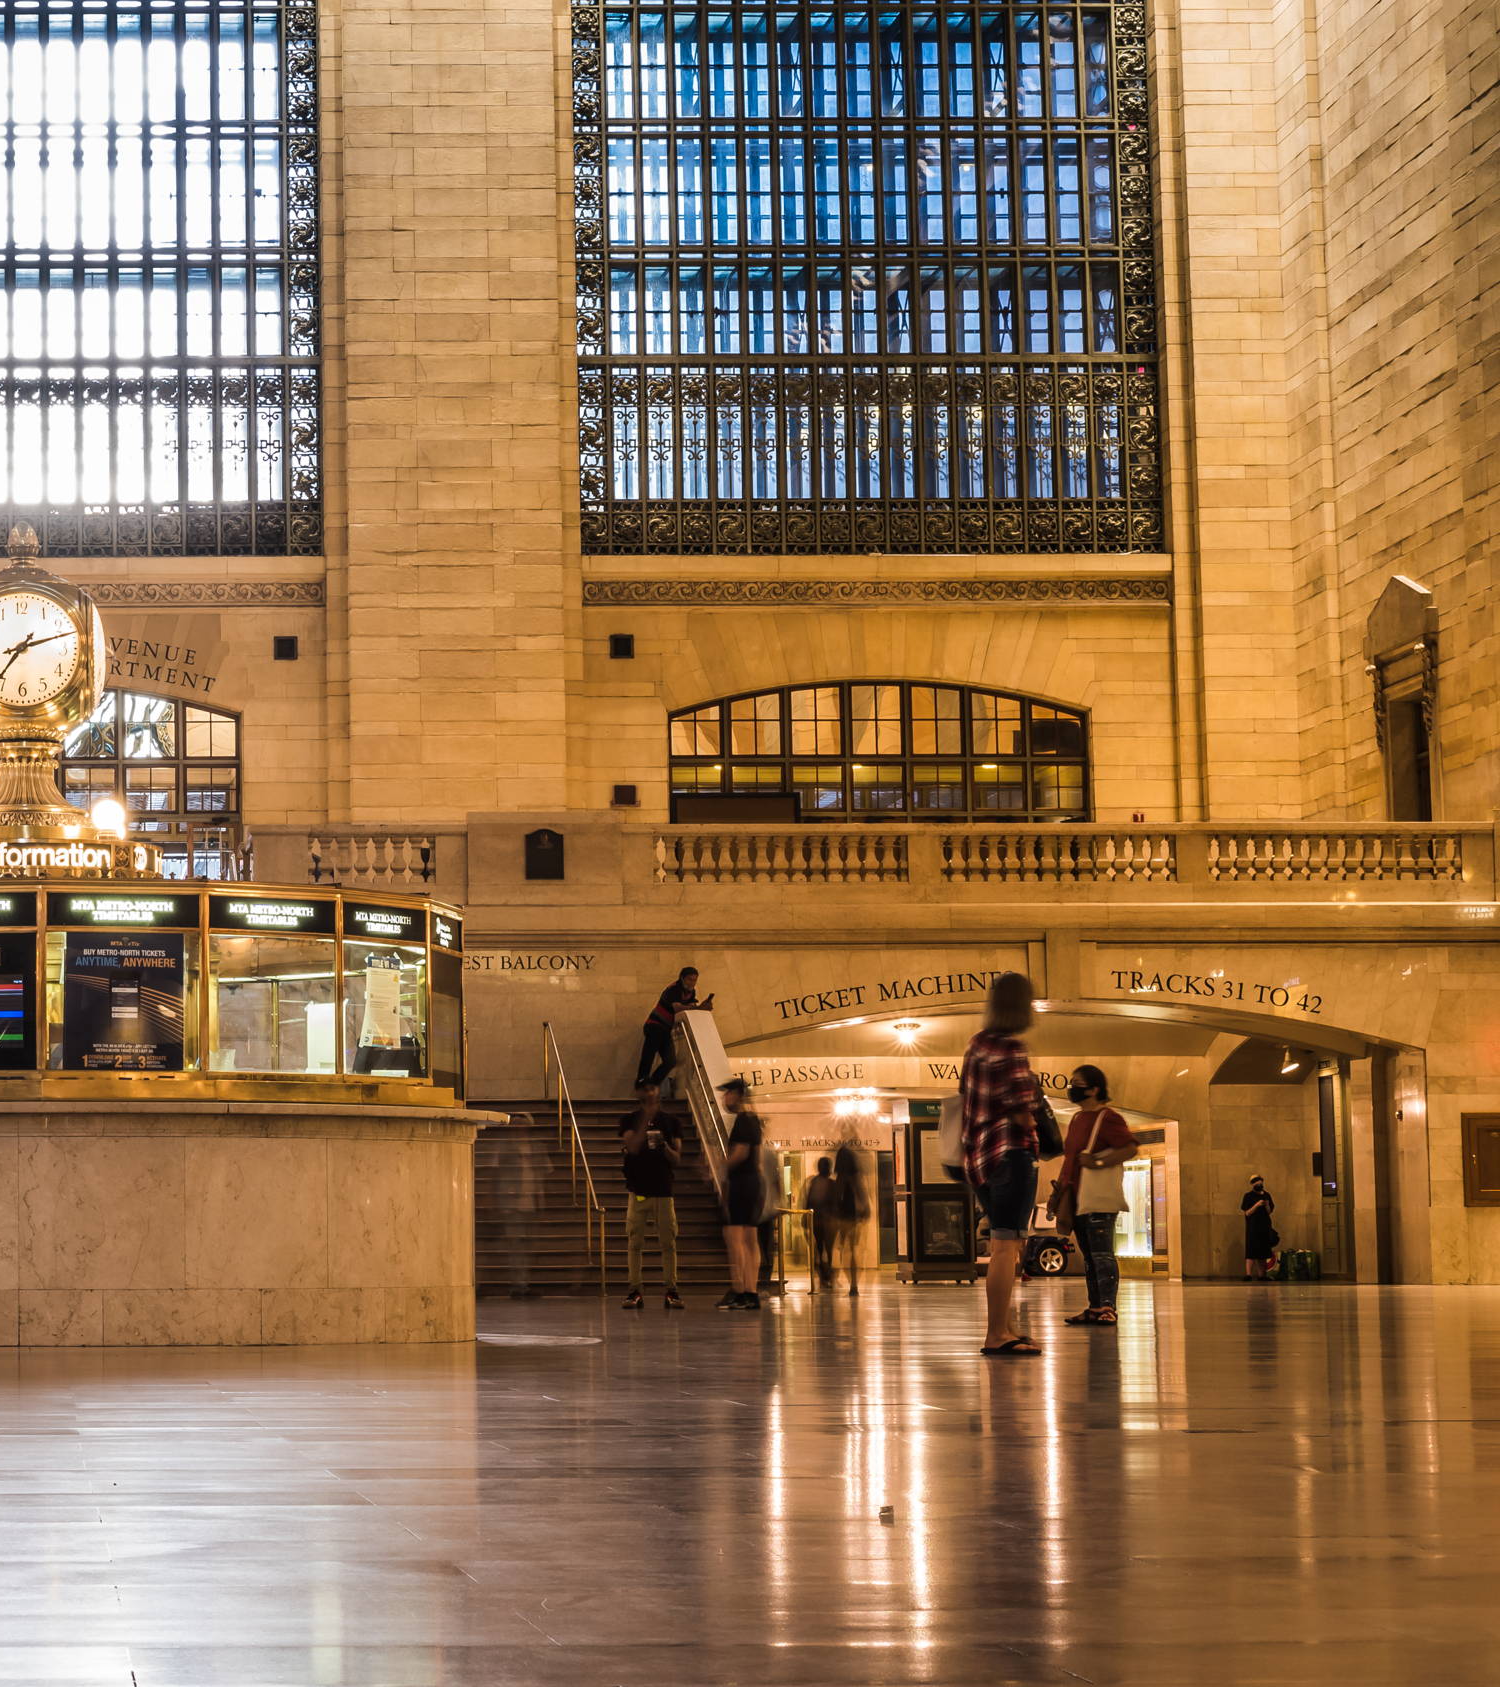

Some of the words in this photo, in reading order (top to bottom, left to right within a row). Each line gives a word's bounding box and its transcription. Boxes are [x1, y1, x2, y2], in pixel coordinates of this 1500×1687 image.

[15, 602, 28, 615] 12
[41, 607, 46, 620] 1
[54, 619, 62, 633] 2
[58, 643, 68, 656] 3
[110, 637, 197, 665] VENUE
[54, 663, 63, 677] 4
[110, 660, 216, 693] RTMENT
[0, 677, 7, 691] 7
[18, 682, 27, 697] 6
[38, 678, 48, 693] 5
[71, 899, 94, 910] MTA
[96, 900, 174, 912] METRO-NORTH
[229, 904, 249, 914] MTA
[250, 905, 314, 917] METRO-NORTH
[355, 912, 369, 922] MTA
[369, 913, 412, 925] METRO-NORTH
[75, 957, 120, 968] ANYTIME,
[123, 957, 176, 968] ANYWHERE
[463, 955, 494, 970] EST
[500, 955, 596, 970] BALCONY
[775, 986, 866, 1020] TICKET
[877, 970, 1013, 1001] MACHINE
[1111, 970, 1215, 996] TRACKS
[1222, 980, 1245, 1001] 31
[1253, 984, 1289, 1007] TO
[1296, 993, 1322, 1014] 42
[82, 1054, 88, 1067] 1
[115, 1055, 122, 1068] 2
[138, 1055, 146, 1068] 3
[770, 1063, 864, 1085] PASSAGE
[801, 1139, 836, 1147] TRACKS
